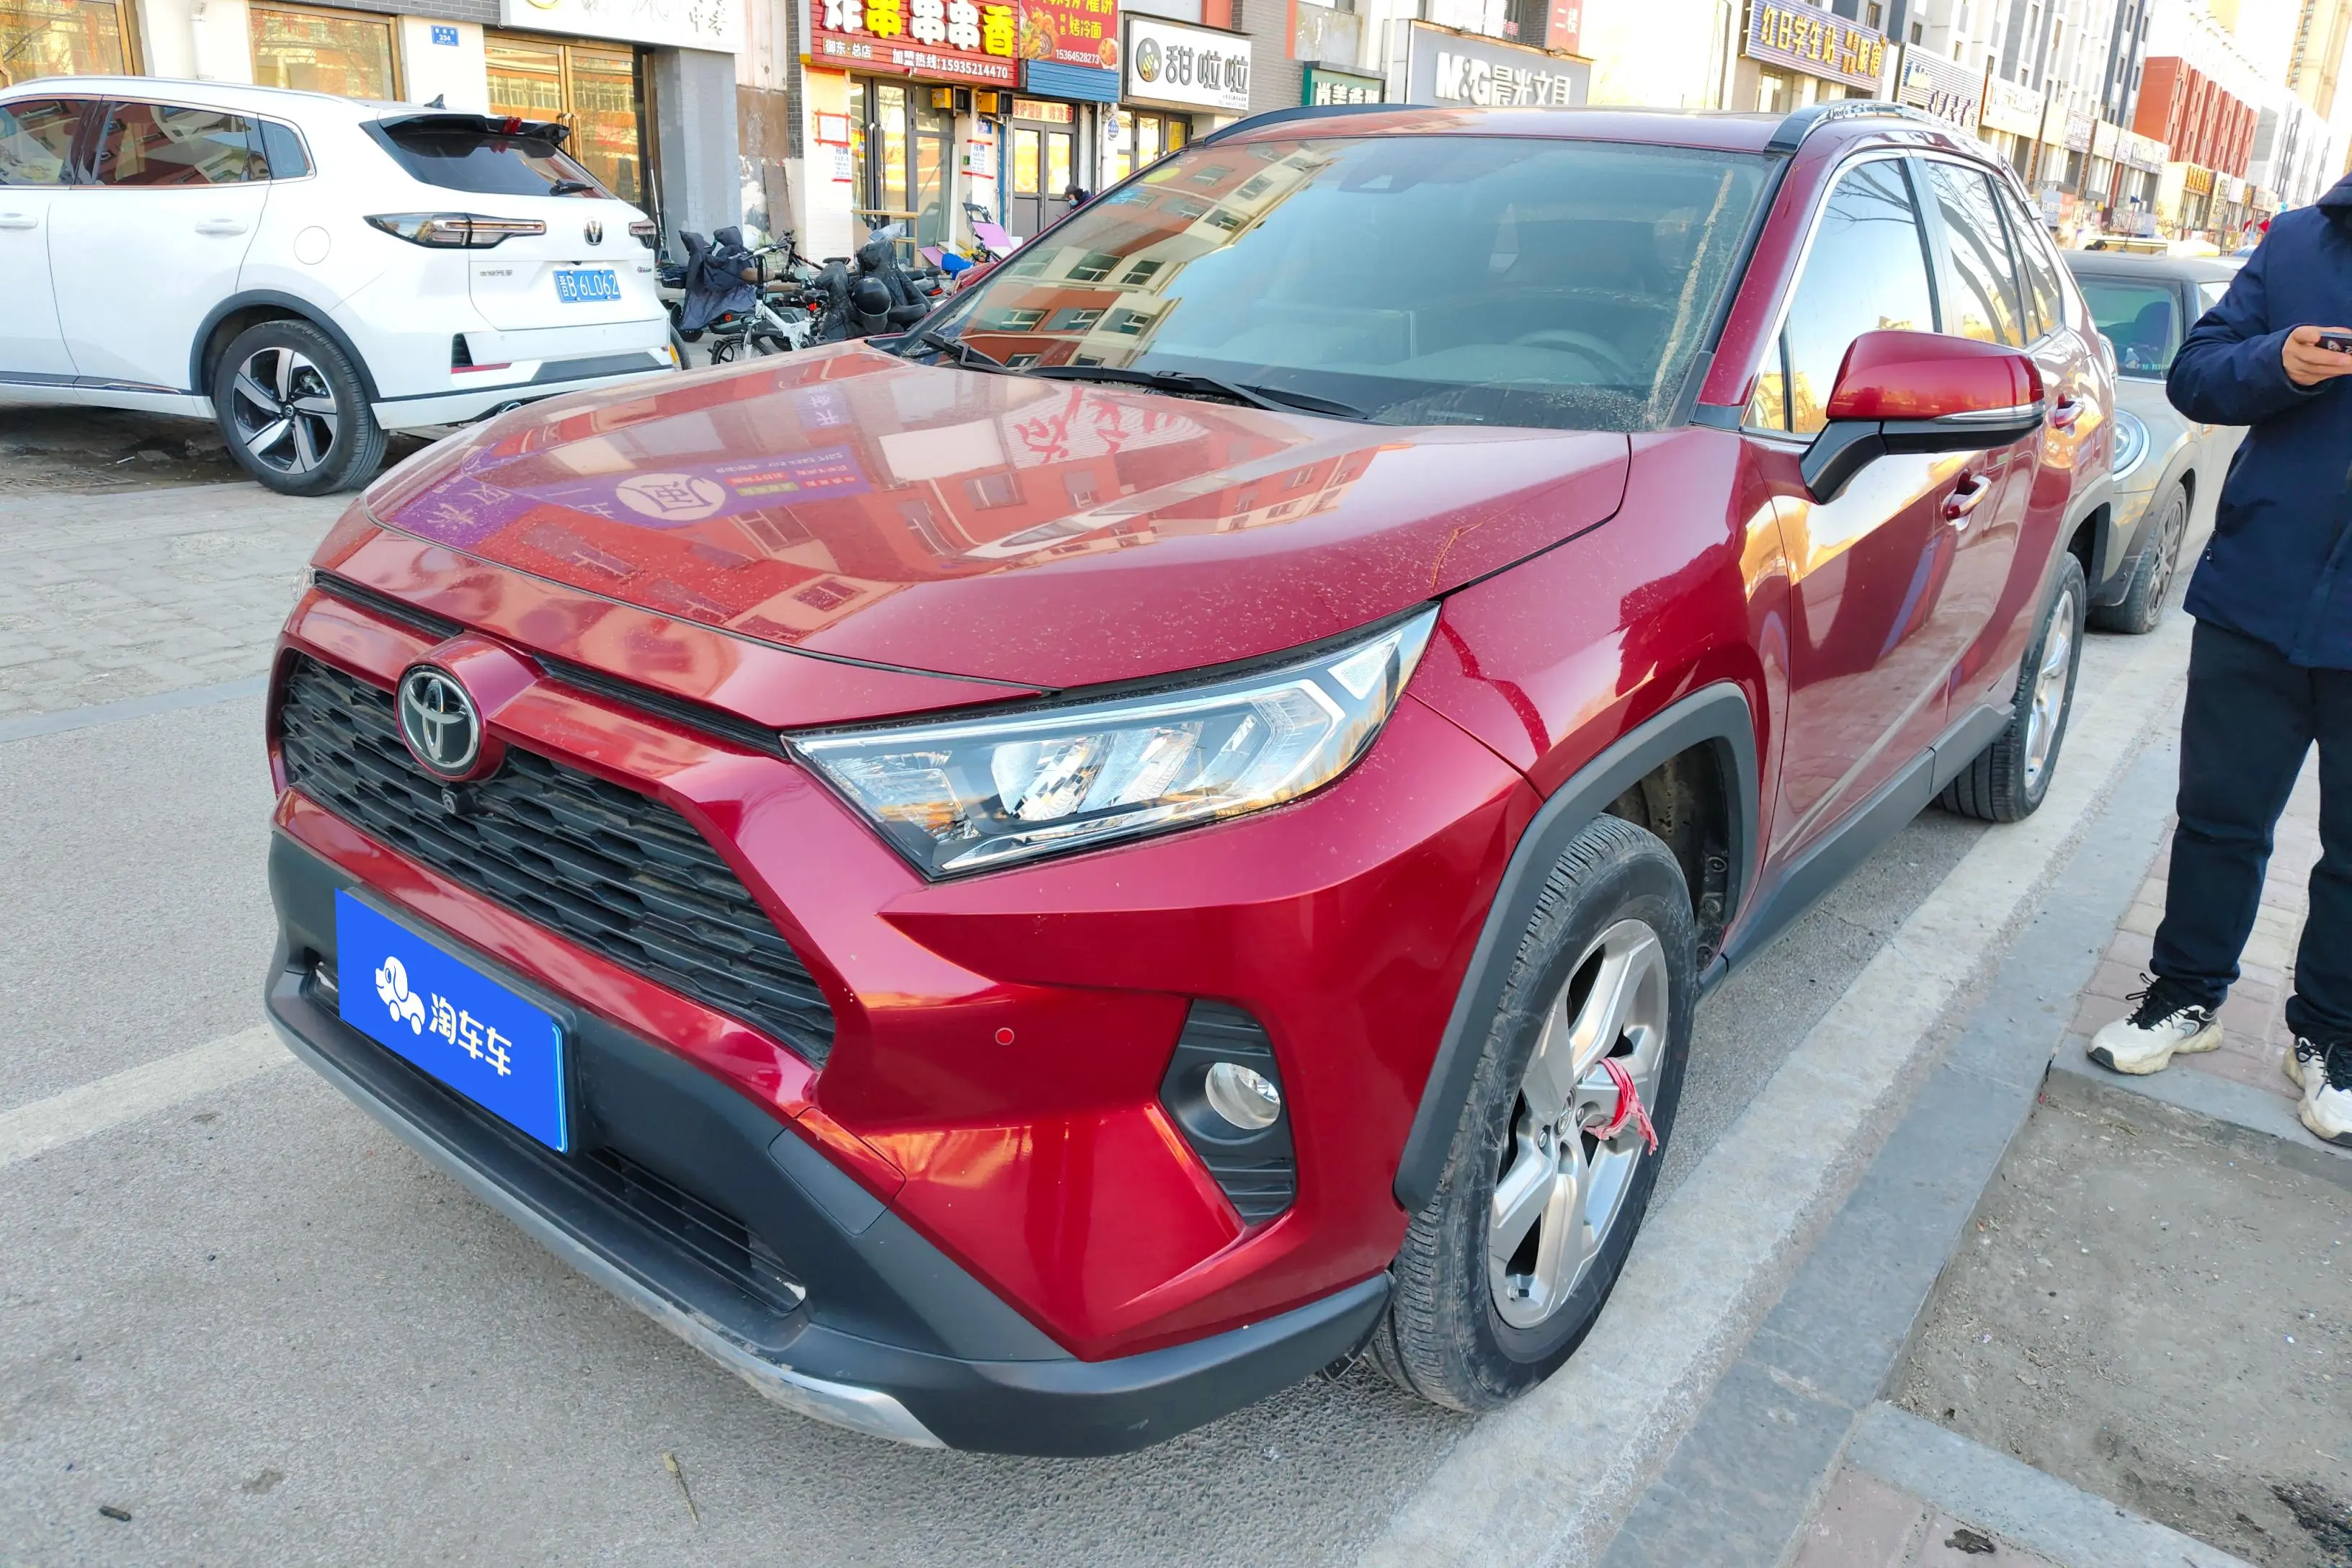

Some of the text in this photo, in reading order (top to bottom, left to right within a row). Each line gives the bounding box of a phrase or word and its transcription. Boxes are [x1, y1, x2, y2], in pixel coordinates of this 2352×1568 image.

[1069, 12, 1102, 39] 烤冷面
[1760, 5, 1837, 64] 红日学生站
[1165, 45, 1249, 94] 甜啦啦
